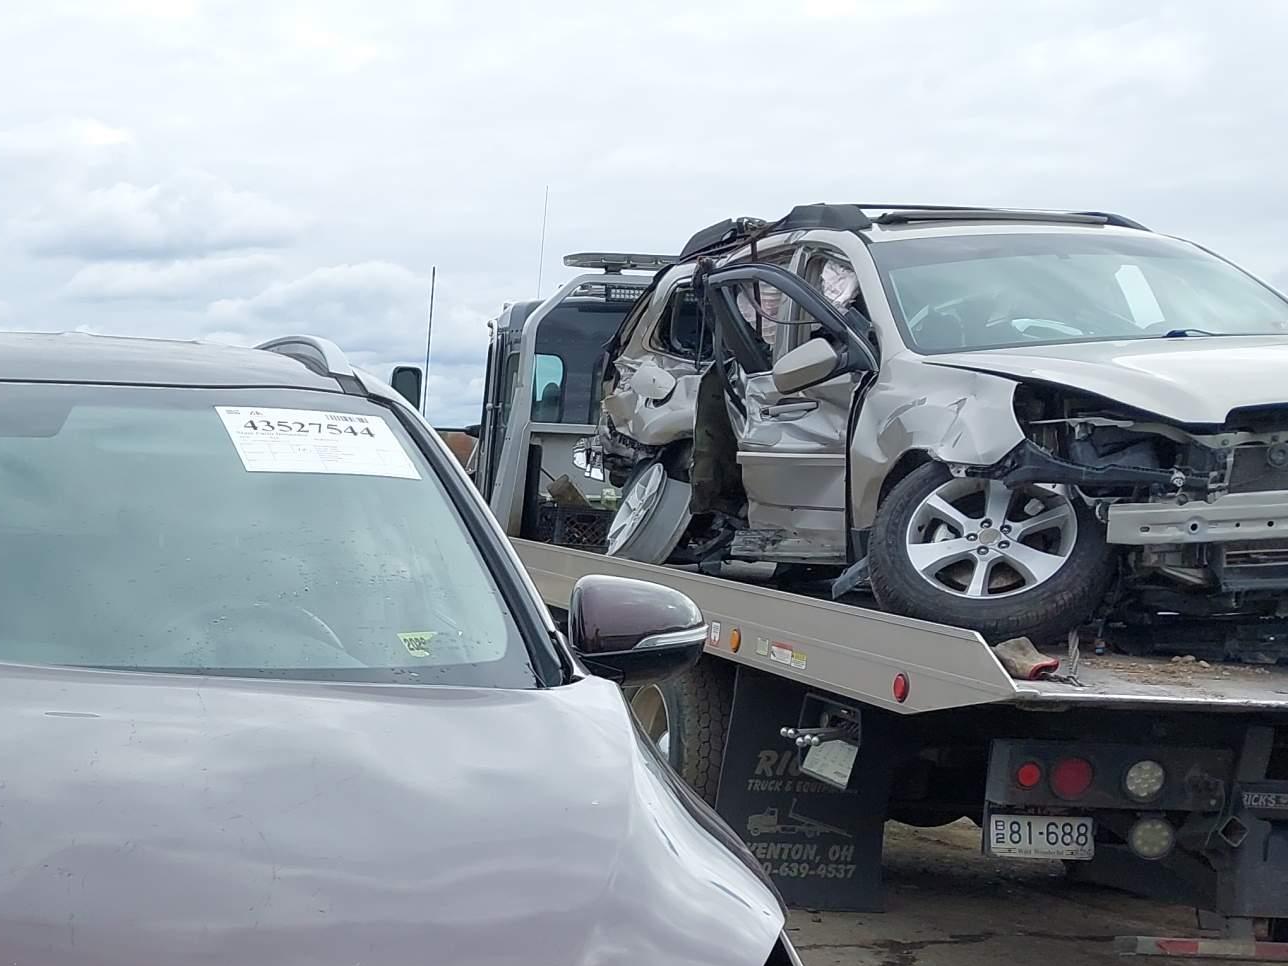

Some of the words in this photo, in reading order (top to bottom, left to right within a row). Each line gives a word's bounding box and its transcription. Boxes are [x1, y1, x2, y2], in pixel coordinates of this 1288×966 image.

[243, 419, 376, 438] 43527544
[747, 778, 783, 793] TRUCK
[1009, 820, 1089, 847] 81-688
[827, 844, 855, 862] OH
[762, 861, 857, 879] 0-639-4537
